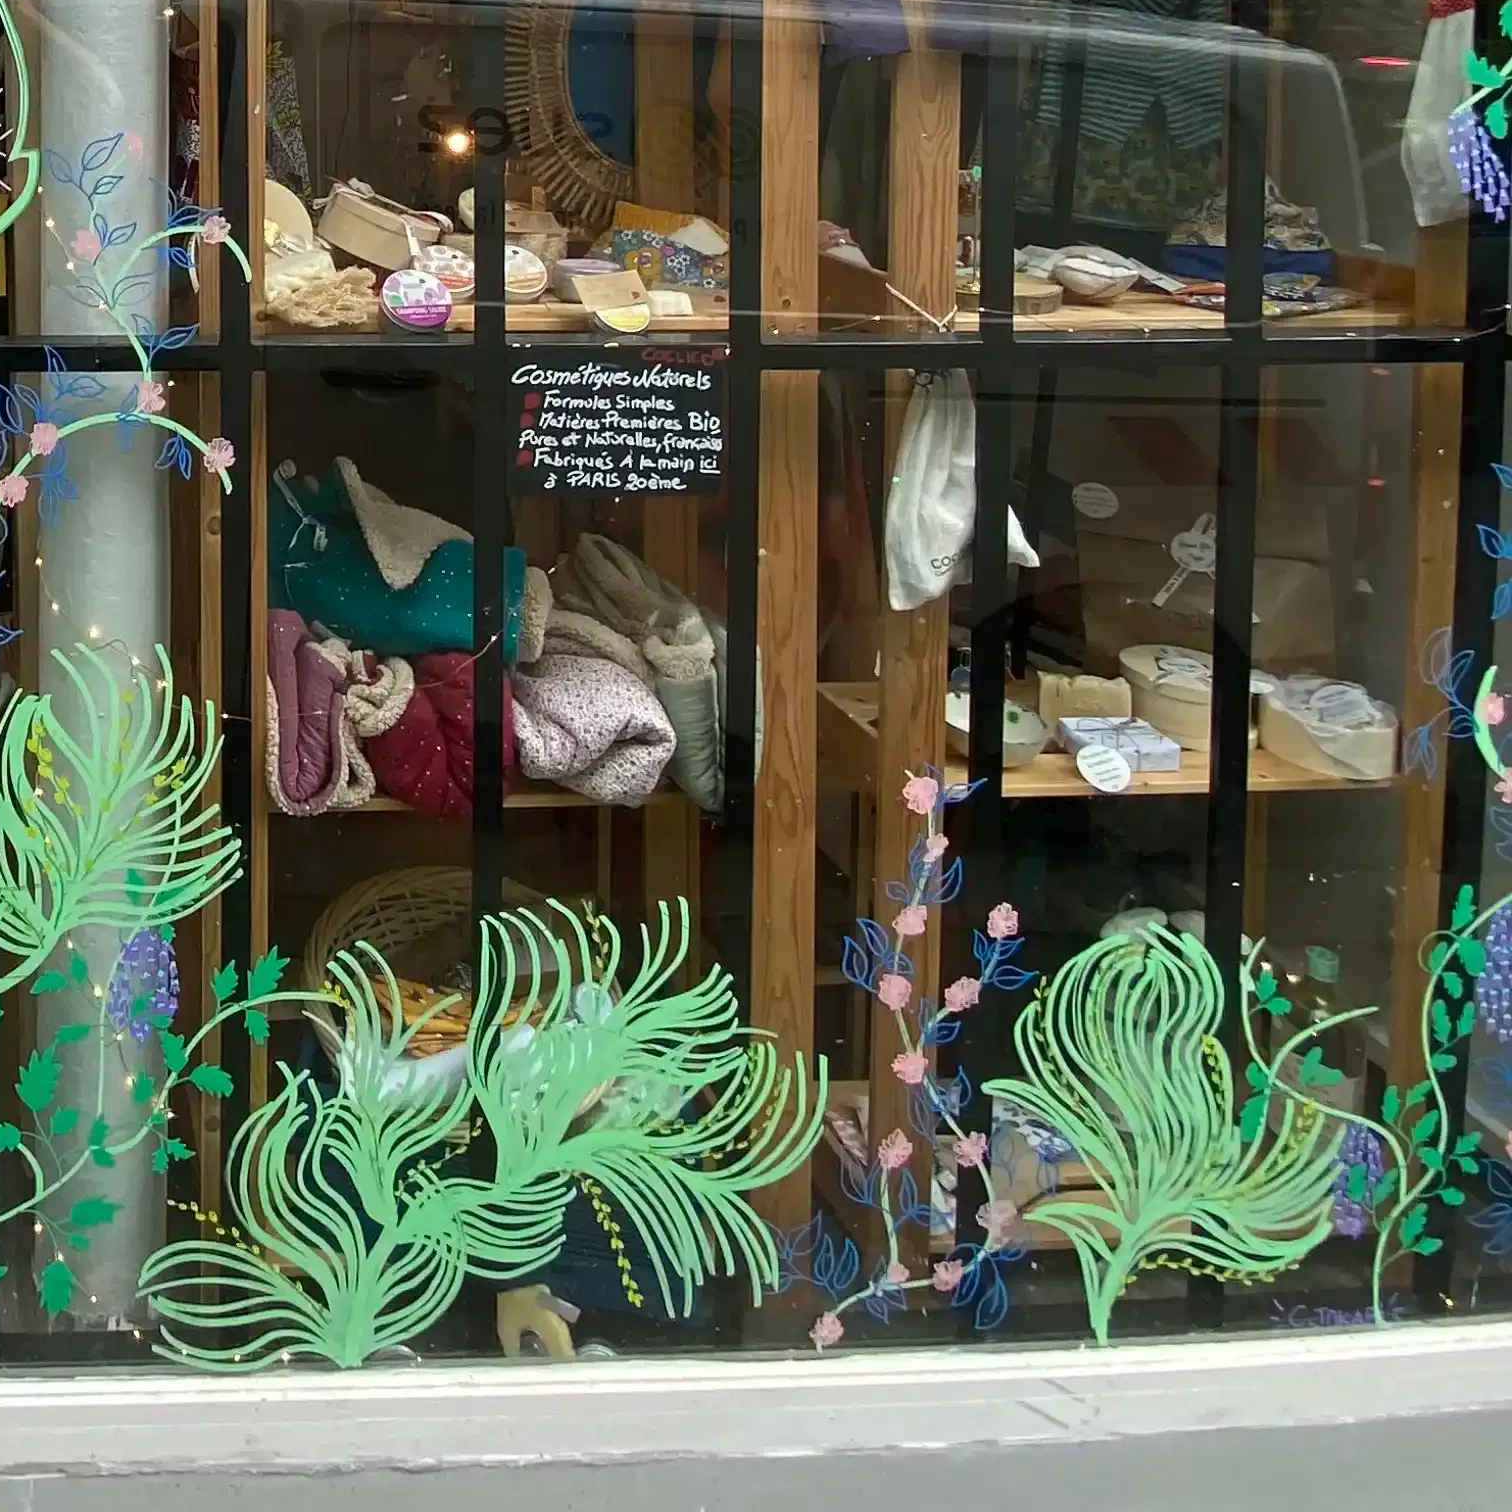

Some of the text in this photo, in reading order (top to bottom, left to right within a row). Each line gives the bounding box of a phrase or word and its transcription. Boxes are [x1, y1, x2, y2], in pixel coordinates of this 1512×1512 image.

[510, 362, 713, 392] Cosmétiques Naturels
[543, 389, 676, 413] Formules Simples
[538, 411, 601, 430] Matières
[601, 410, 683, 431] Premières
[518, 429, 559, 449] Pures
[561, 432, 580, 446] et
[533, 447, 614, 471] Fabriqués
[657, 456, 695, 472] main
[699, 453, 718, 471] ici
[565, 470, 623, 489] PARIS
[624, 473, 688, 491] 20ème
